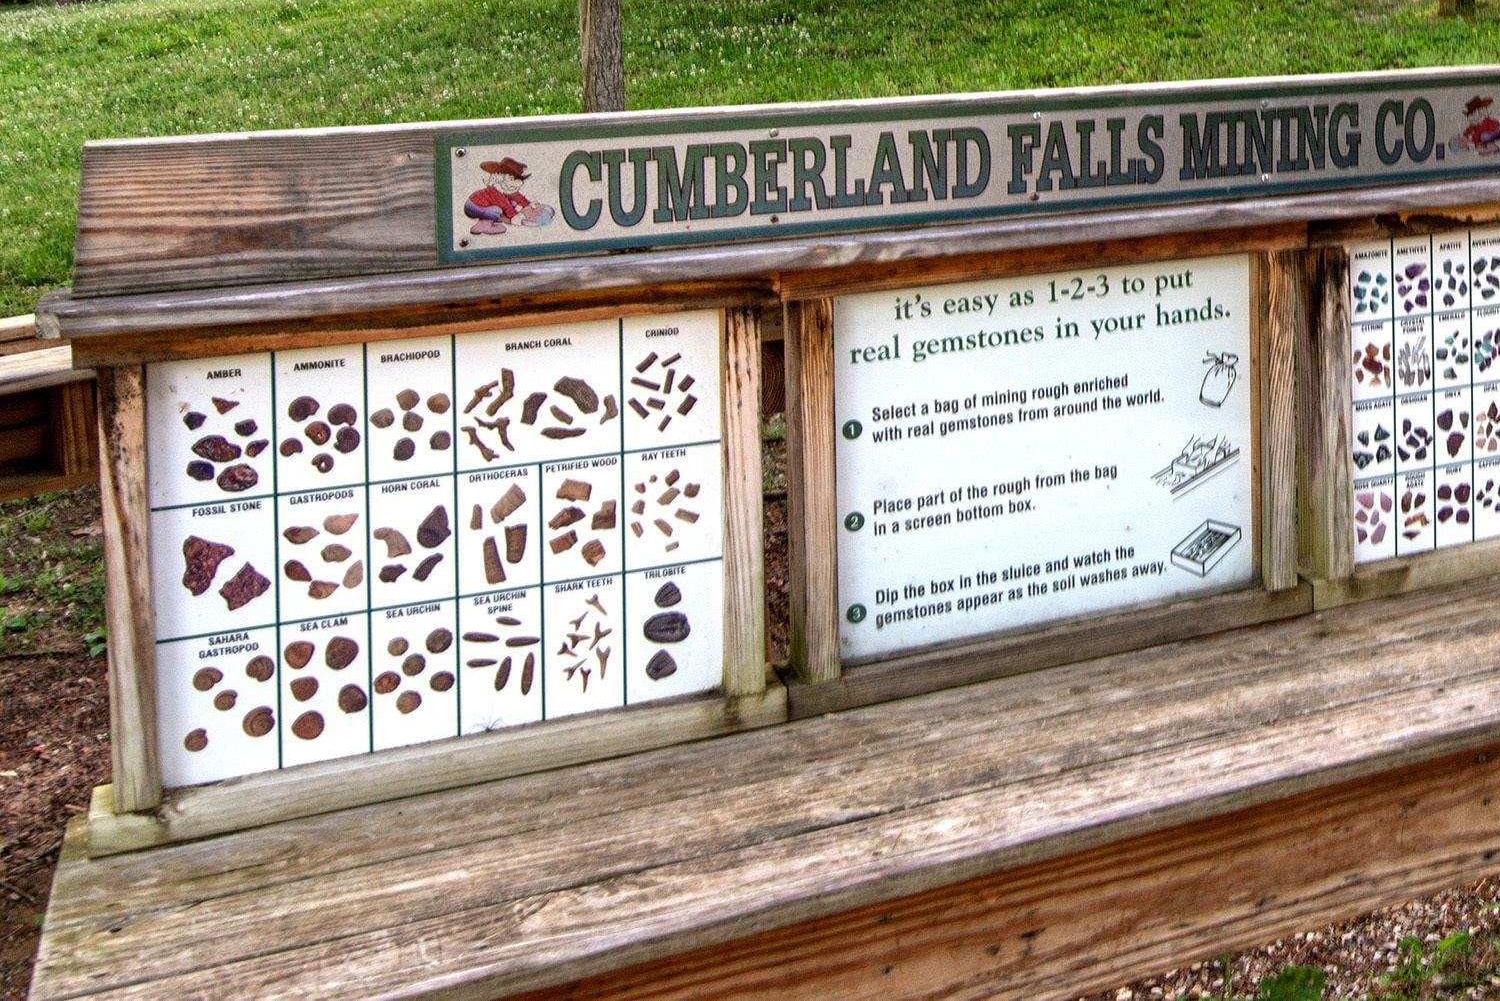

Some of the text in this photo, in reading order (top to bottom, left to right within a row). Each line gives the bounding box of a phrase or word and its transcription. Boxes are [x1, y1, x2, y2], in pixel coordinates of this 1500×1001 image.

[559, 97, 1445, 231] CUMBERLAND FALLS MINING CO.
[1397, 247, 1426, 255] AMETHYST
[1440, 242, 1461, 250] APATITE
[1354, 251, 1387, 260] AMAZONITE
[894, 269, 1194, 320] it's easy as 1-2-3 to put
[1400, 318, 1425, 326] CRYSTAL
[1438, 313, 1465, 322] EMERALD
[850, 298, 1231, 364] real gemstones in your hands.
[1361, 324, 1383, 332] CITRINE
[1403, 325, 1423, 333] POINTS
[505, 337, 572, 351] BRANCH CORAL
[380, 350, 440, 363] BRACHIOPOD
[294, 359, 345, 371] AMMONITE
[207, 369, 241, 380] AMBER
[872, 374, 1128, 422] Select a bag of mining rough enriched
[1401, 396, 1427, 406] OBSIDIAN
[1445, 391, 1461, 399] ONYX
[1374, 401, 1391, 409] AGATE
[872, 389, 1165, 443] with real gemstones from around the world.
[642, 449, 686, 462] RAY TEETH
[545, 457, 617, 474] PETRIFIED WOOD
[1446, 467, 1461, 475] RUBY
[469, 468, 528, 483] ORTHOCERAS
[381, 479, 440, 494] HORN CORAL
[873, 464, 1117, 515] Place part of the rough from the bag
[1406, 480, 1424, 488] AGATE
[289, 490, 354, 505] GASTROPODS
[192, 501, 261, 517] FOSSIL STONE
[873, 497, 1036, 536] in a screen bottom box.
[644, 566, 686, 580] TRILOBITE
[875, 544, 1135, 606] Dip the box in the sluice and watch the
[555, 578, 612, 593] SHARK TEETH
[474, 591, 526, 606] SEA URCHIN
[875, 561, 1167, 628] gemstones appear as the soil washes away.
[386, 603, 440, 619] SEA URCHIN
[488, 604, 513, 615] SPINE
[300, 617, 348, 632] SEA CLAM
[208, 633, 249, 646] SAHARA
[199, 642, 259, 659] GASTROPOD
